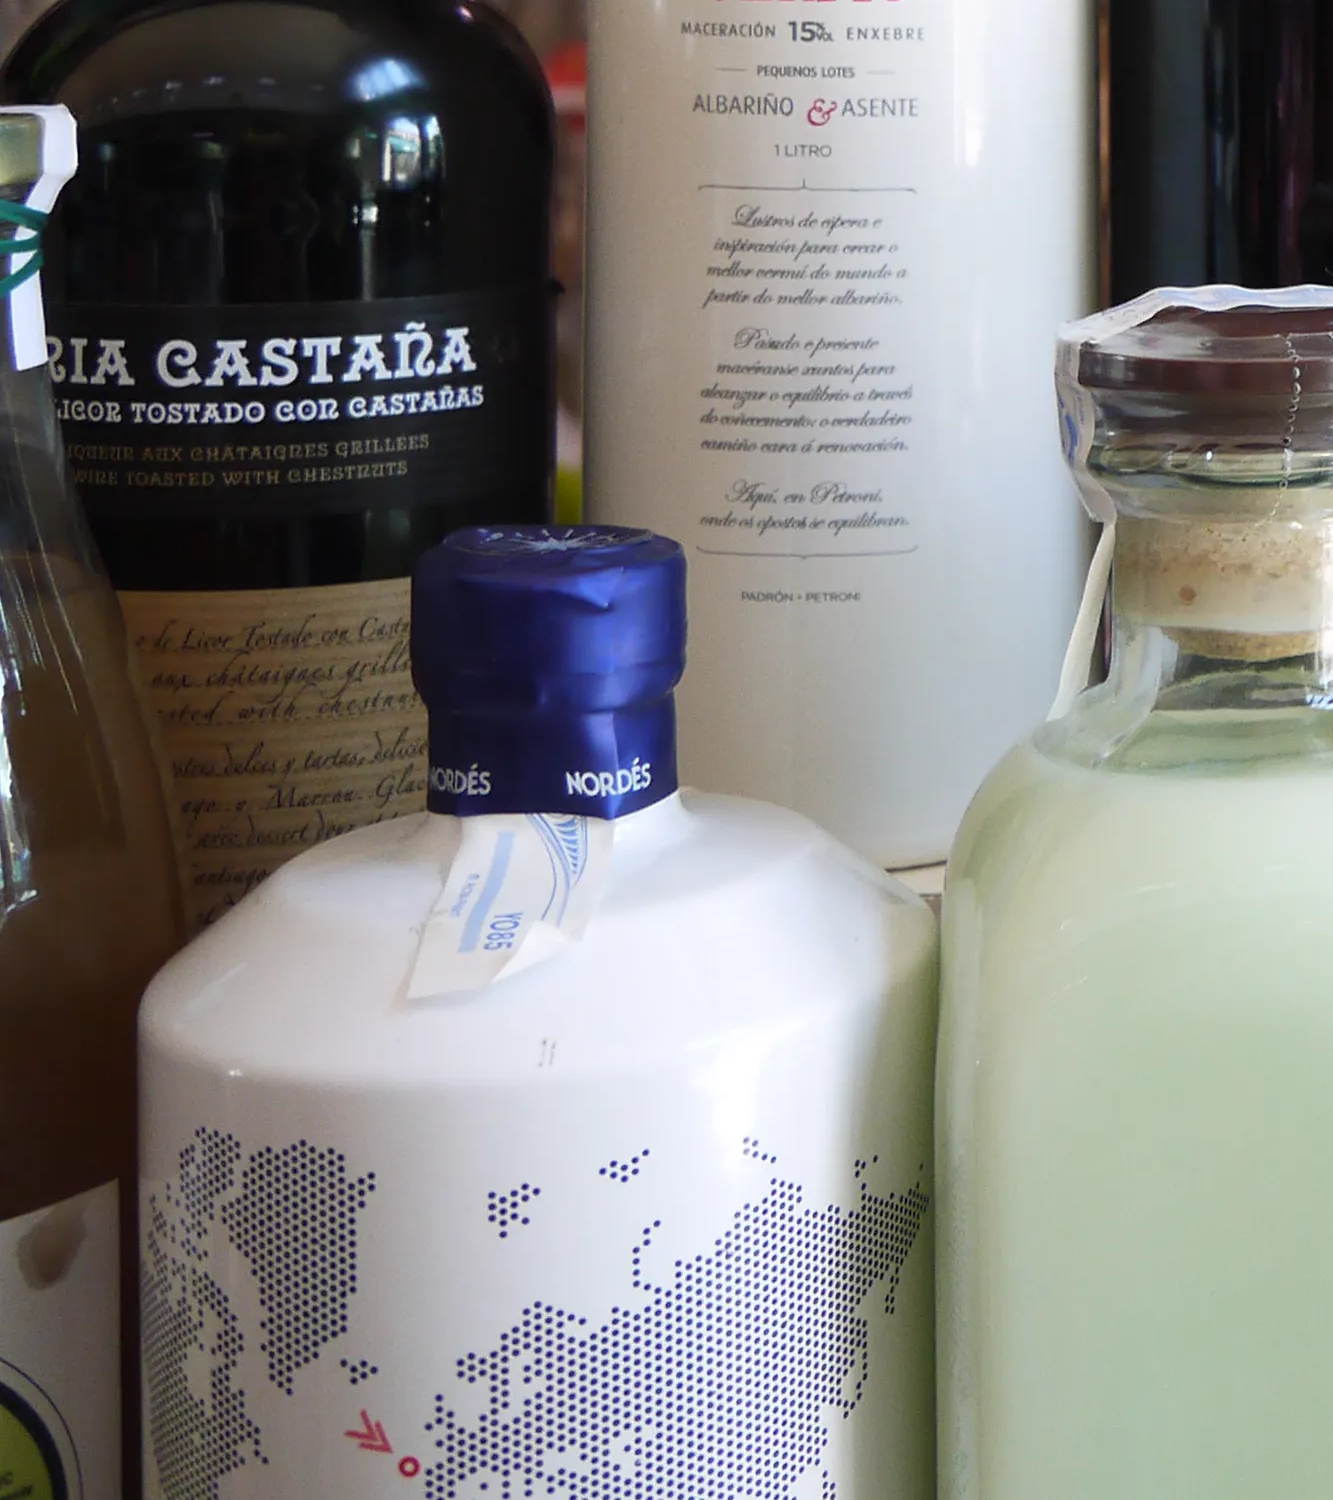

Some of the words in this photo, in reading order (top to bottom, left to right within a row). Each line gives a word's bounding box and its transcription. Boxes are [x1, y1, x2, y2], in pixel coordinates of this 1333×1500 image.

[680, 20, 776, 38] MACERACIÓN
[847, 26, 926, 42] ENXEBRE
[756, 65, 817, 78] PEQUENOS
[821, 66, 855, 78] LOTES
[692, 93, 794, 116] ALBARIÑO
[807, 98, 838, 126] &
[841, 98, 919, 117] ASENTE
[774, 144, 782, 157] 1
[785, 144, 832, 158] LITRO
[731, 204, 794, 228] Lustros
[797, 212, 815, 228] de
[820, 216, 868, 236] espera
[872, 218, 882, 228] e
[713, 238, 796, 259] inspiración
[793, 241, 837, 261] para
[843, 242, 884, 253] crear
[706, 260, 752, 278] mellor
[755, 264, 805, 279] vermú
[809, 264, 829, 279] do
[834, 265, 892, 279] mundo
[896, 269, 907, 279] a
[701, 289, 750, 309] partir
[752, 289, 774, 304] do
[776, 288, 826, 305] mellor
[157, 321, 477, 388] CASTAÑA
[804, 339, 813, 350] e
[850, 363, 895, 382] para
[132, 403, 266, 424] TOSTADO
[275, 398, 339, 421] CON
[349, 385, 484, 418] CASTAÑAS
[769, 389, 780, 401] o
[782, 384, 850, 409] equilibrio
[853, 389, 865, 401] a
[700, 407, 718, 424] do
[830, 410, 912, 427] verdadeiro
[142, 447, 183, 462] AUX
[700, 437, 758, 452] camiño
[760, 441, 797, 453] cara
[125, 471, 215, 487] TOASTED
[222, 469, 280, 487] WITH
[287, 461, 408, 483] CHESTNUTS
[783, 492, 806, 504] en
[699, 511, 737, 529] onde
[741, 587, 793, 603] PADRÓN
[565, 757, 652, 798] NORDÉS
